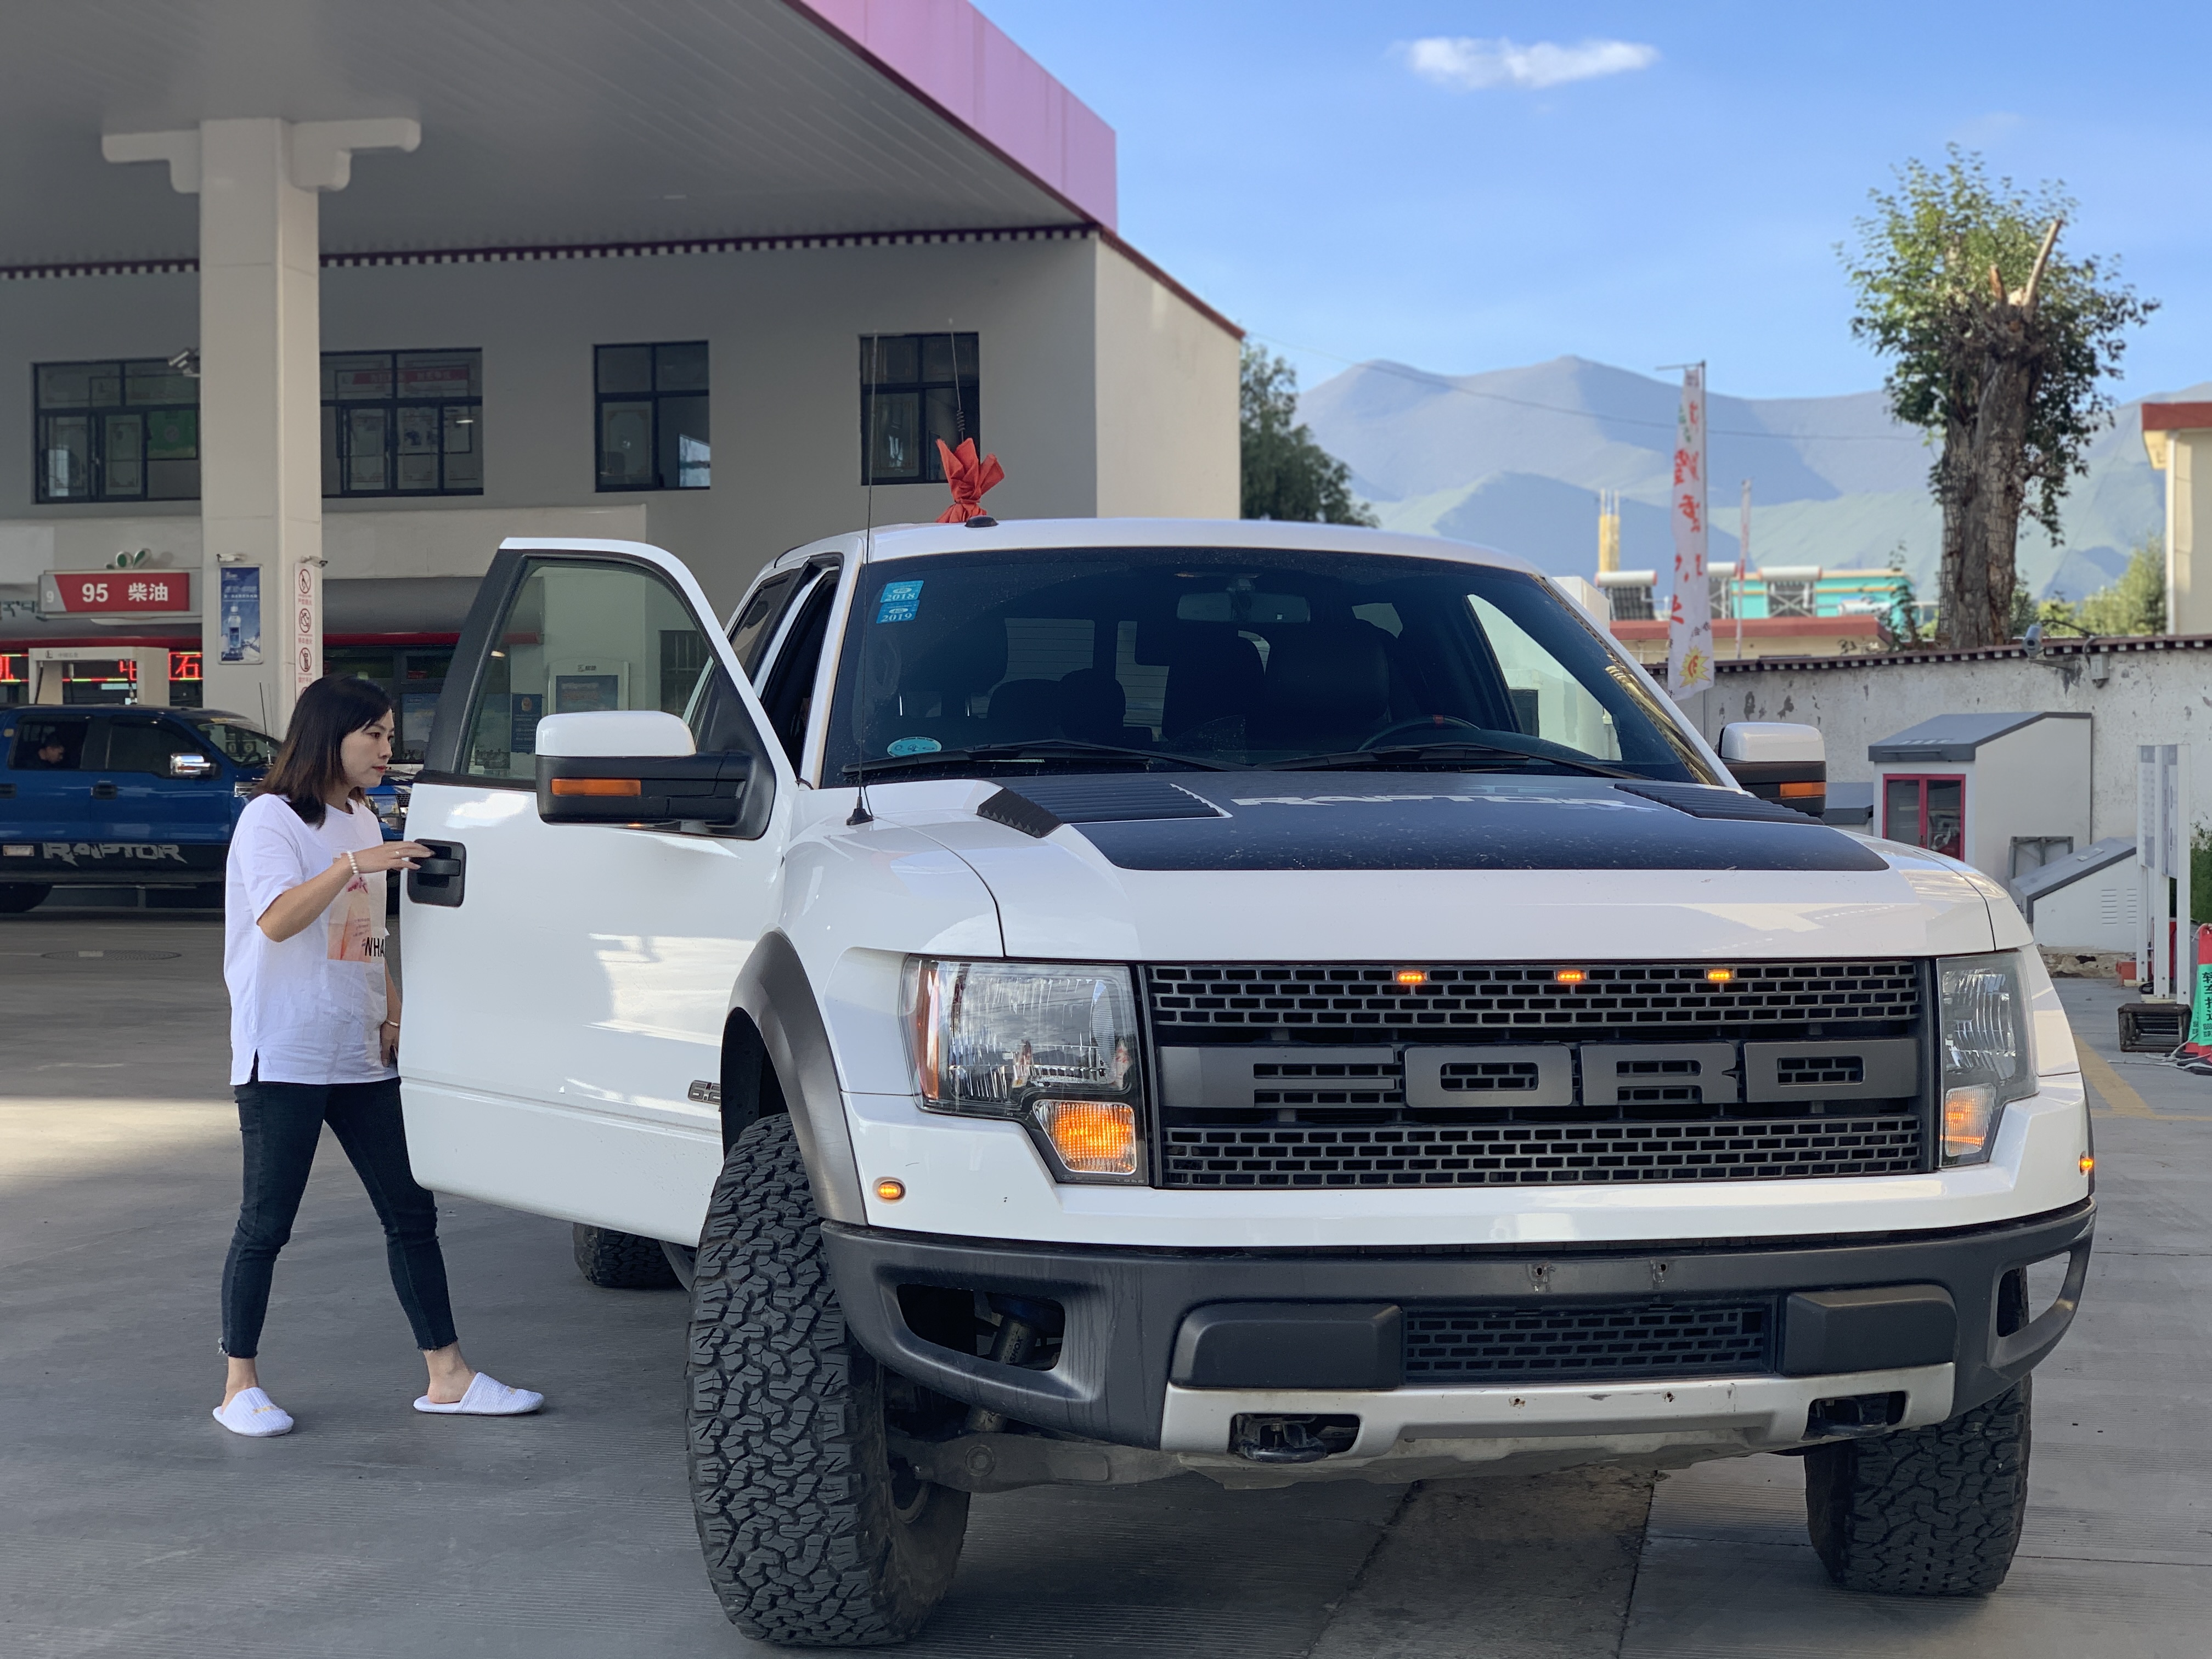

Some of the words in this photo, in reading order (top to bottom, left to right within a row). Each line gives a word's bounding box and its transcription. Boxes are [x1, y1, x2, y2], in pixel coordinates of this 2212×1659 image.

[46, 591, 54, 602] 9
[82, 583, 108, 602] 95
[128, 583, 168, 601] 柴油
[884, 593, 915, 601] 2018
[881, 613, 912, 622] 2019
[1231, 795, 1661, 812] RAPTOR
[43, 843, 187, 867] RAPTOR
[1159, 1038, 1920, 1108] FORD
